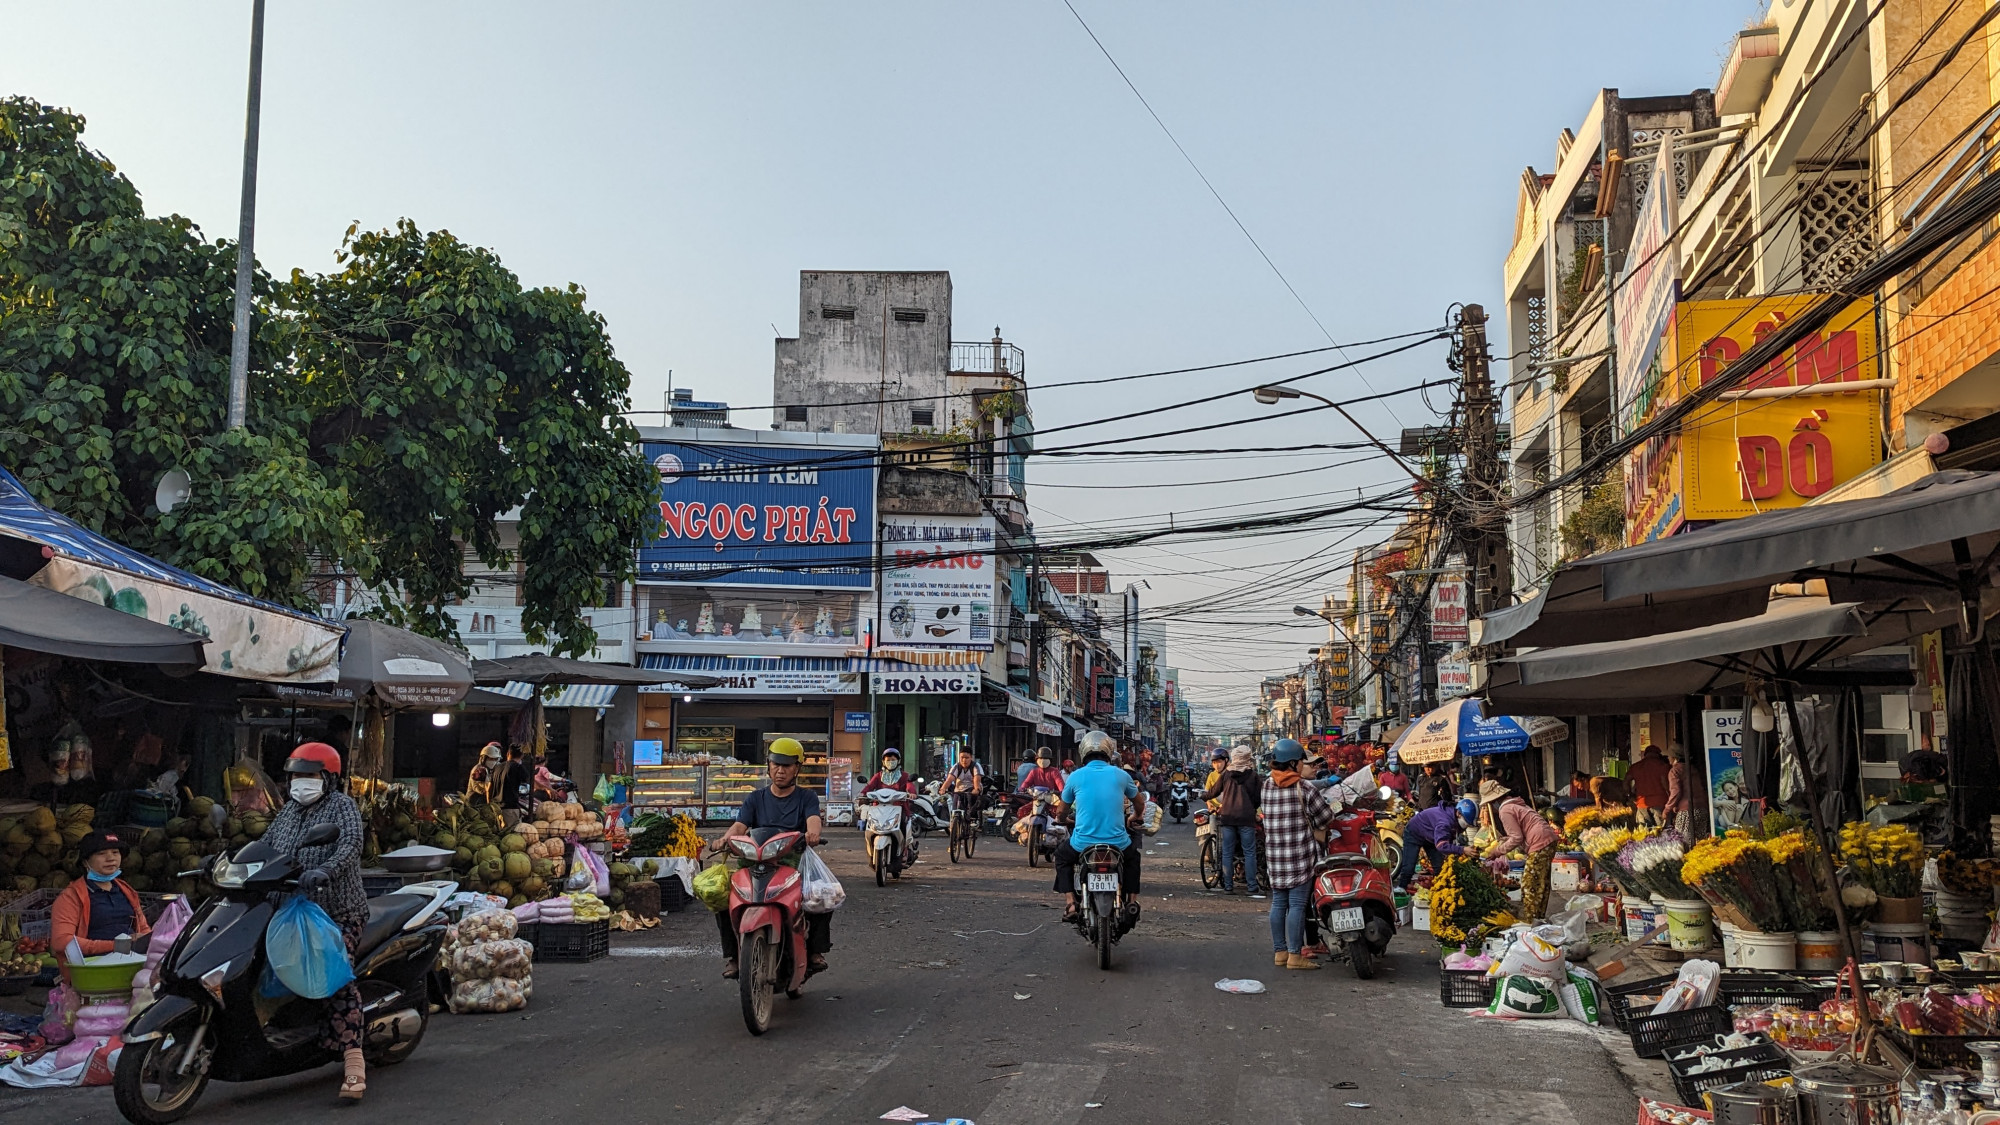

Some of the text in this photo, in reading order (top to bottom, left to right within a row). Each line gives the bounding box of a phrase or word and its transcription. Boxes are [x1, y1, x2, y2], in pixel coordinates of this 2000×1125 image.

[1735, 409, 1834, 500] ĐỒ
[698, 457, 818, 485] BÁNH KEM
[659, 496, 856, 552] NGỌC PHÁT
[939, 523, 954, 542] KÍNH
[674, 562, 696, 570] PHAN
[895, 545, 984, 570] HOÀNG
[1434, 604, 1465, 624] HIỆP
[720, 674, 757, 688] PHÁT
[1332, 667, 1348, 676] KIM
[884, 675, 964, 692] HOÀNG
